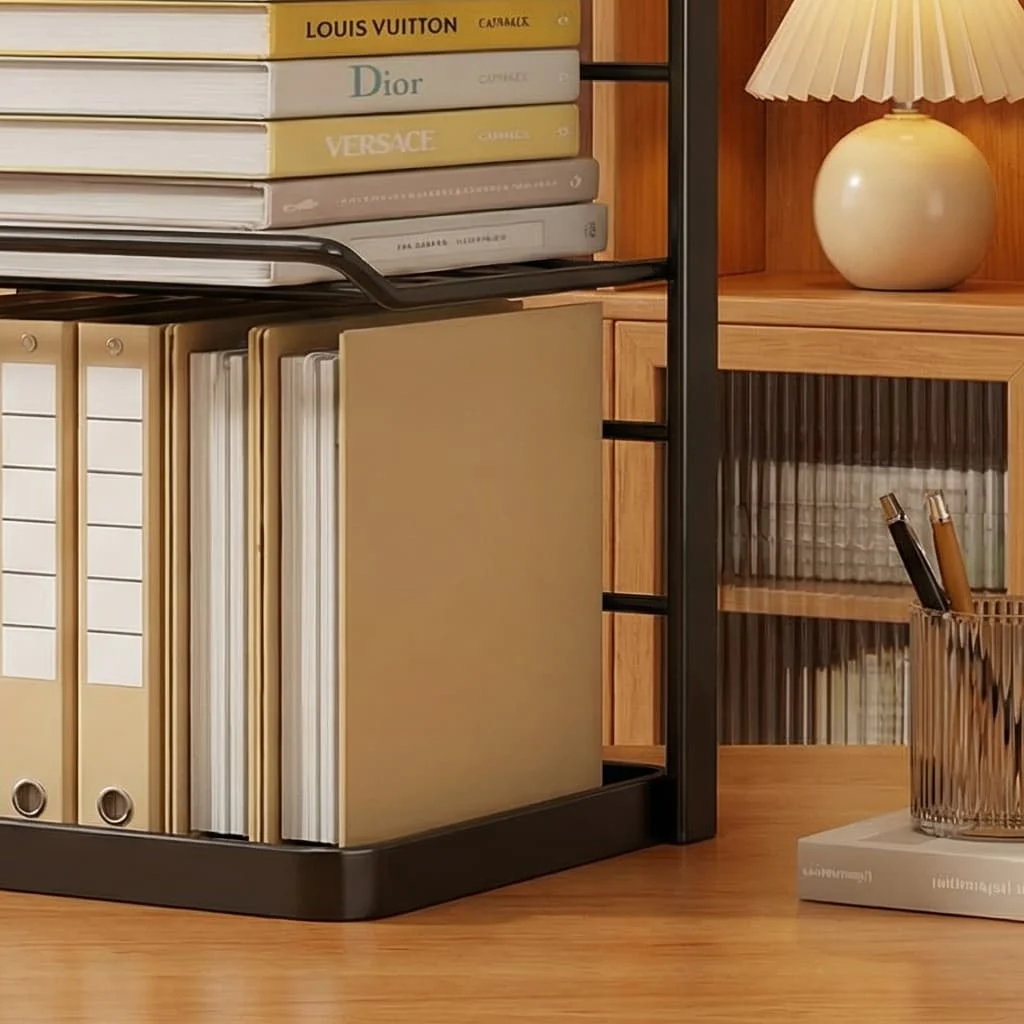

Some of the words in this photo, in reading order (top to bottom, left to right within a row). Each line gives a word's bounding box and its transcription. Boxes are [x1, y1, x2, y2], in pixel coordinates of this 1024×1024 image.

[306, 19, 368, 39] LOUIS
[372, 16, 458, 36] VUITTON
[347, 64, 424, 98] Dior
[324, 129, 437, 158] VERSACE
